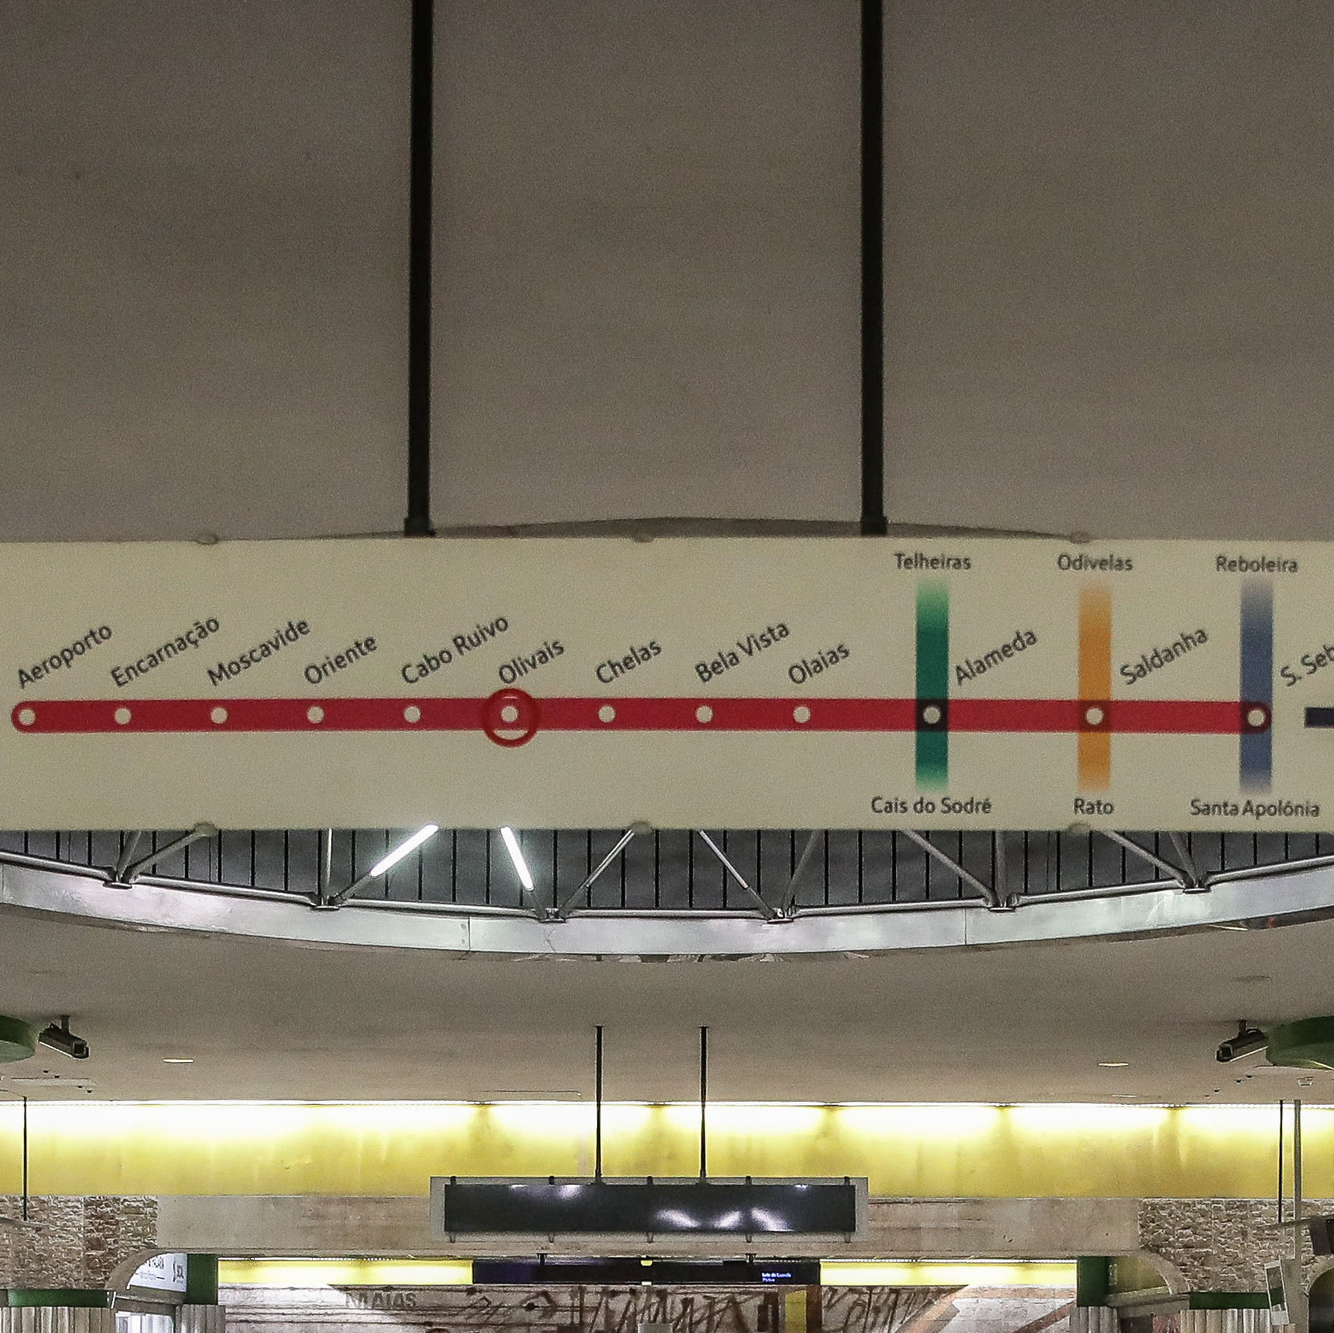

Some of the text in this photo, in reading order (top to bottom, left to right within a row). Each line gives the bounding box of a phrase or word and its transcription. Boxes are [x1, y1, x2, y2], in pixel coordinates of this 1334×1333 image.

[893, 551, 972, 571] Telheiras
[1056, 553, 1134, 572] Odivelas
[1215, 555, 1299, 574] Reboleira
[17, 624, 113, 690] Aeroporto
[109, 615, 220, 688] Encarnação
[206, 616, 311, 687] Moscavide
[303, 632, 378, 685] Oriente
[400, 616, 509, 686] Cabo Ruivo
[496, 637, 566, 686] Olivais
[595, 640, 663, 685] Chelas
[694, 621, 791, 684] Bela Vista
[787, 641, 851, 685] Olaias
[953, 628, 1038, 686] Alameda
[1120, 626, 1209, 685] Saldanha
[1280, 666, 1303, 687] S.
[870, 795, 993, 815] Cais do Sodré
[1073, 796, 1115, 816] Rato
[1190, 798, 1321, 820] Santa Apolónia
